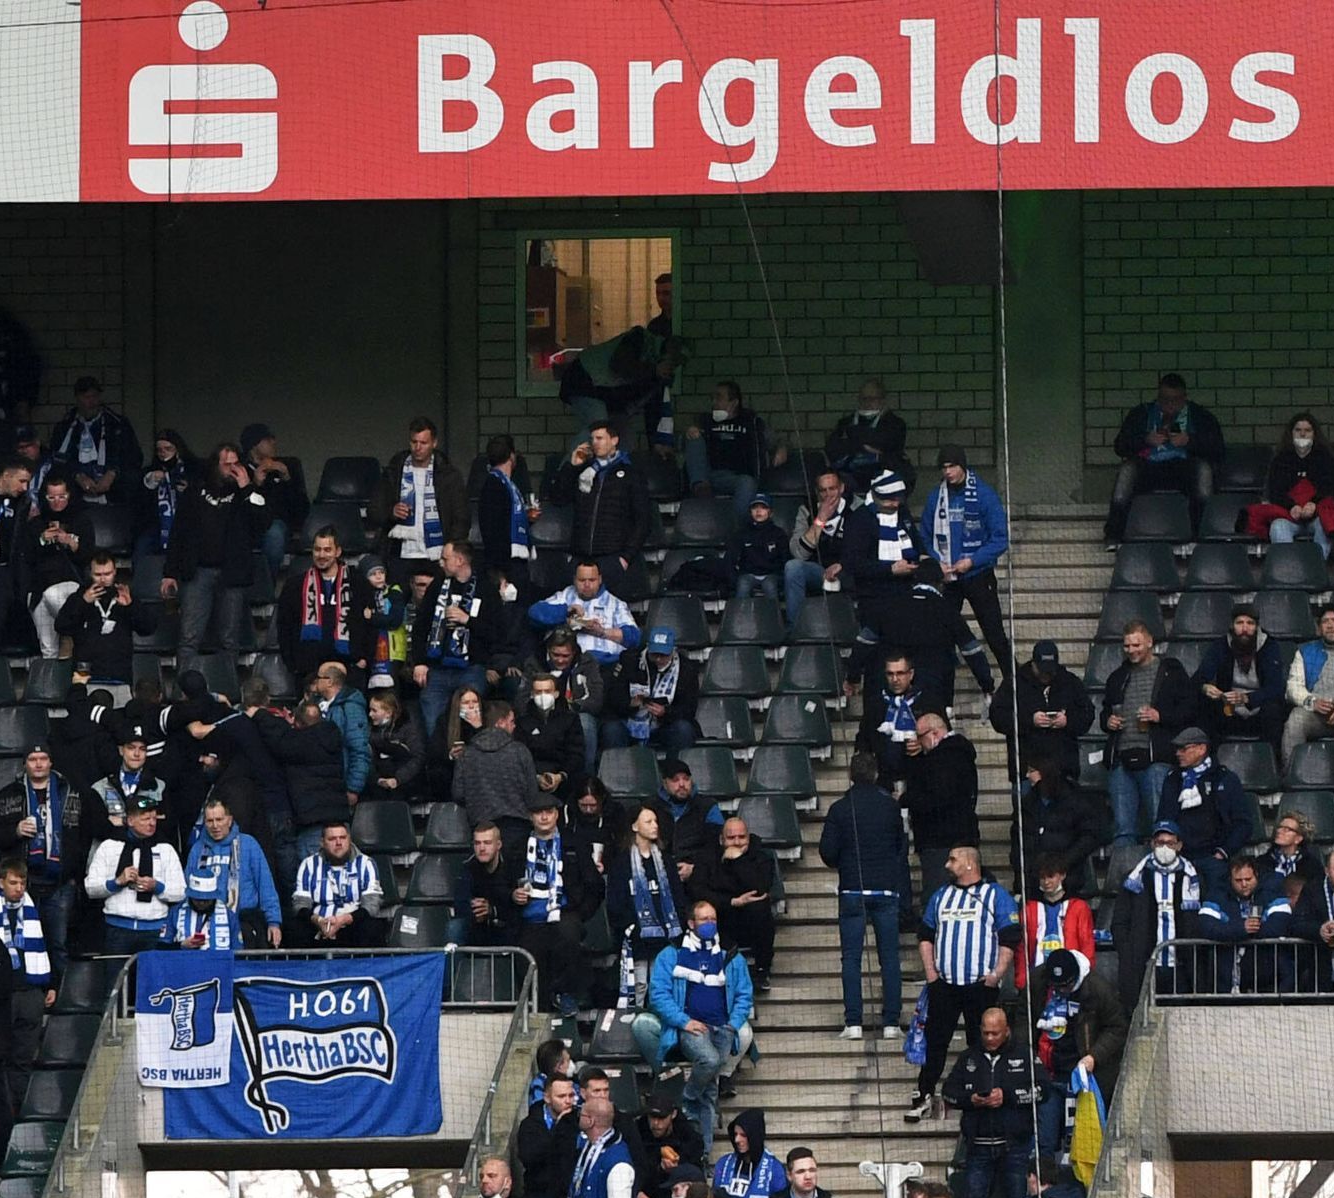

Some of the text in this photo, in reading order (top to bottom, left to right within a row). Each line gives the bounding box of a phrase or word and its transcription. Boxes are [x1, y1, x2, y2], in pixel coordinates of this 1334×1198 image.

[417, 17, 1301, 183] Bargeldlos
[142, 1066, 222, 1080] HERTHA BSC
